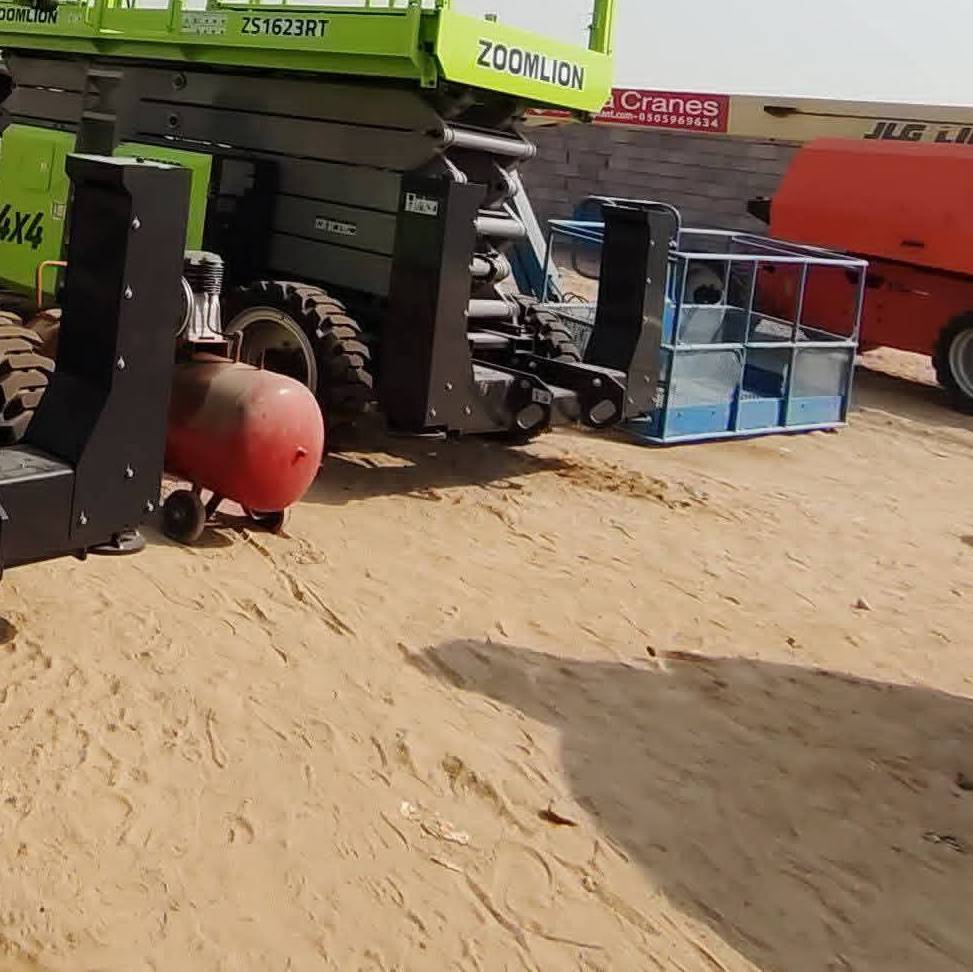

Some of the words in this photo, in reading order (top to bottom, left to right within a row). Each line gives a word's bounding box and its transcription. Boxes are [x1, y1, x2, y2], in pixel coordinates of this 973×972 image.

[241, 16, 329, 37] ZS1623RT
[476, 38, 584, 91] ZOOMLION
[621, 91, 719, 117] Cranes
[863, 121, 927, 141] JLG
